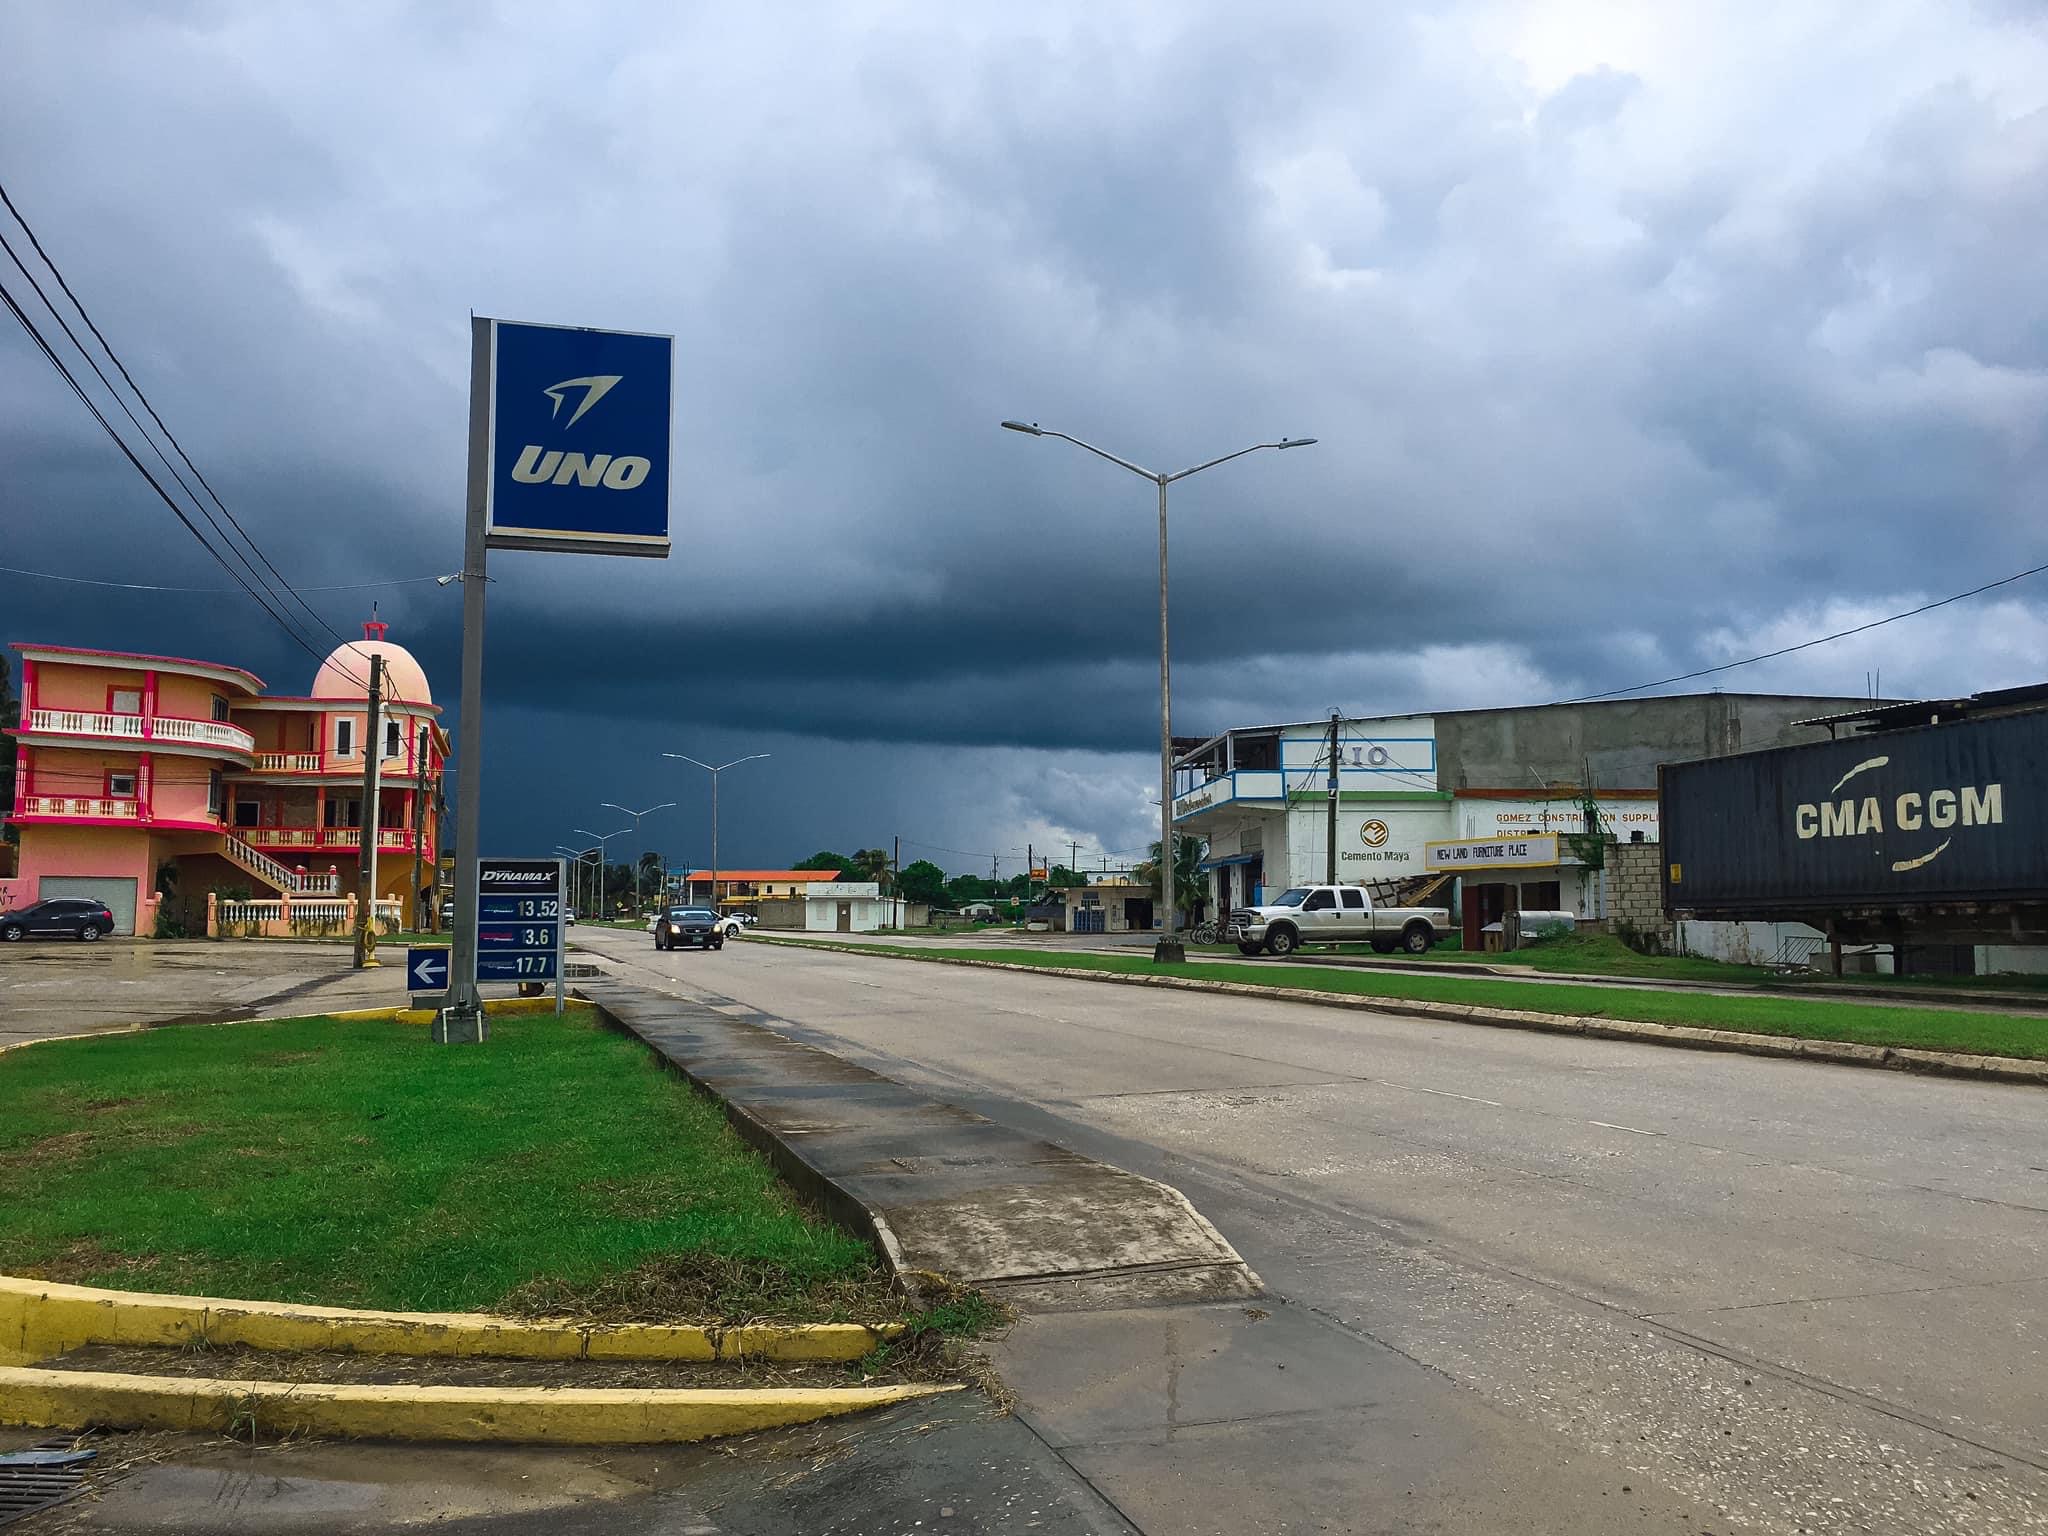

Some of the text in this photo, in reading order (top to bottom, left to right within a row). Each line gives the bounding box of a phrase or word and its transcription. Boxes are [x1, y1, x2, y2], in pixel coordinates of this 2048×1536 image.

[511, 445, 651, 490] UNO
[1496, 813, 1532, 822] GOMEZ
[1796, 784, 2003, 839] CMA CGM
[1341, 851, 1410, 863] Cemento Maya
[1437, 843, 1528, 860] NEW LAND FURNITURE PLACE
[481, 870, 557, 881] DYNAMAX
[517, 900, 558, 917] 13.52
